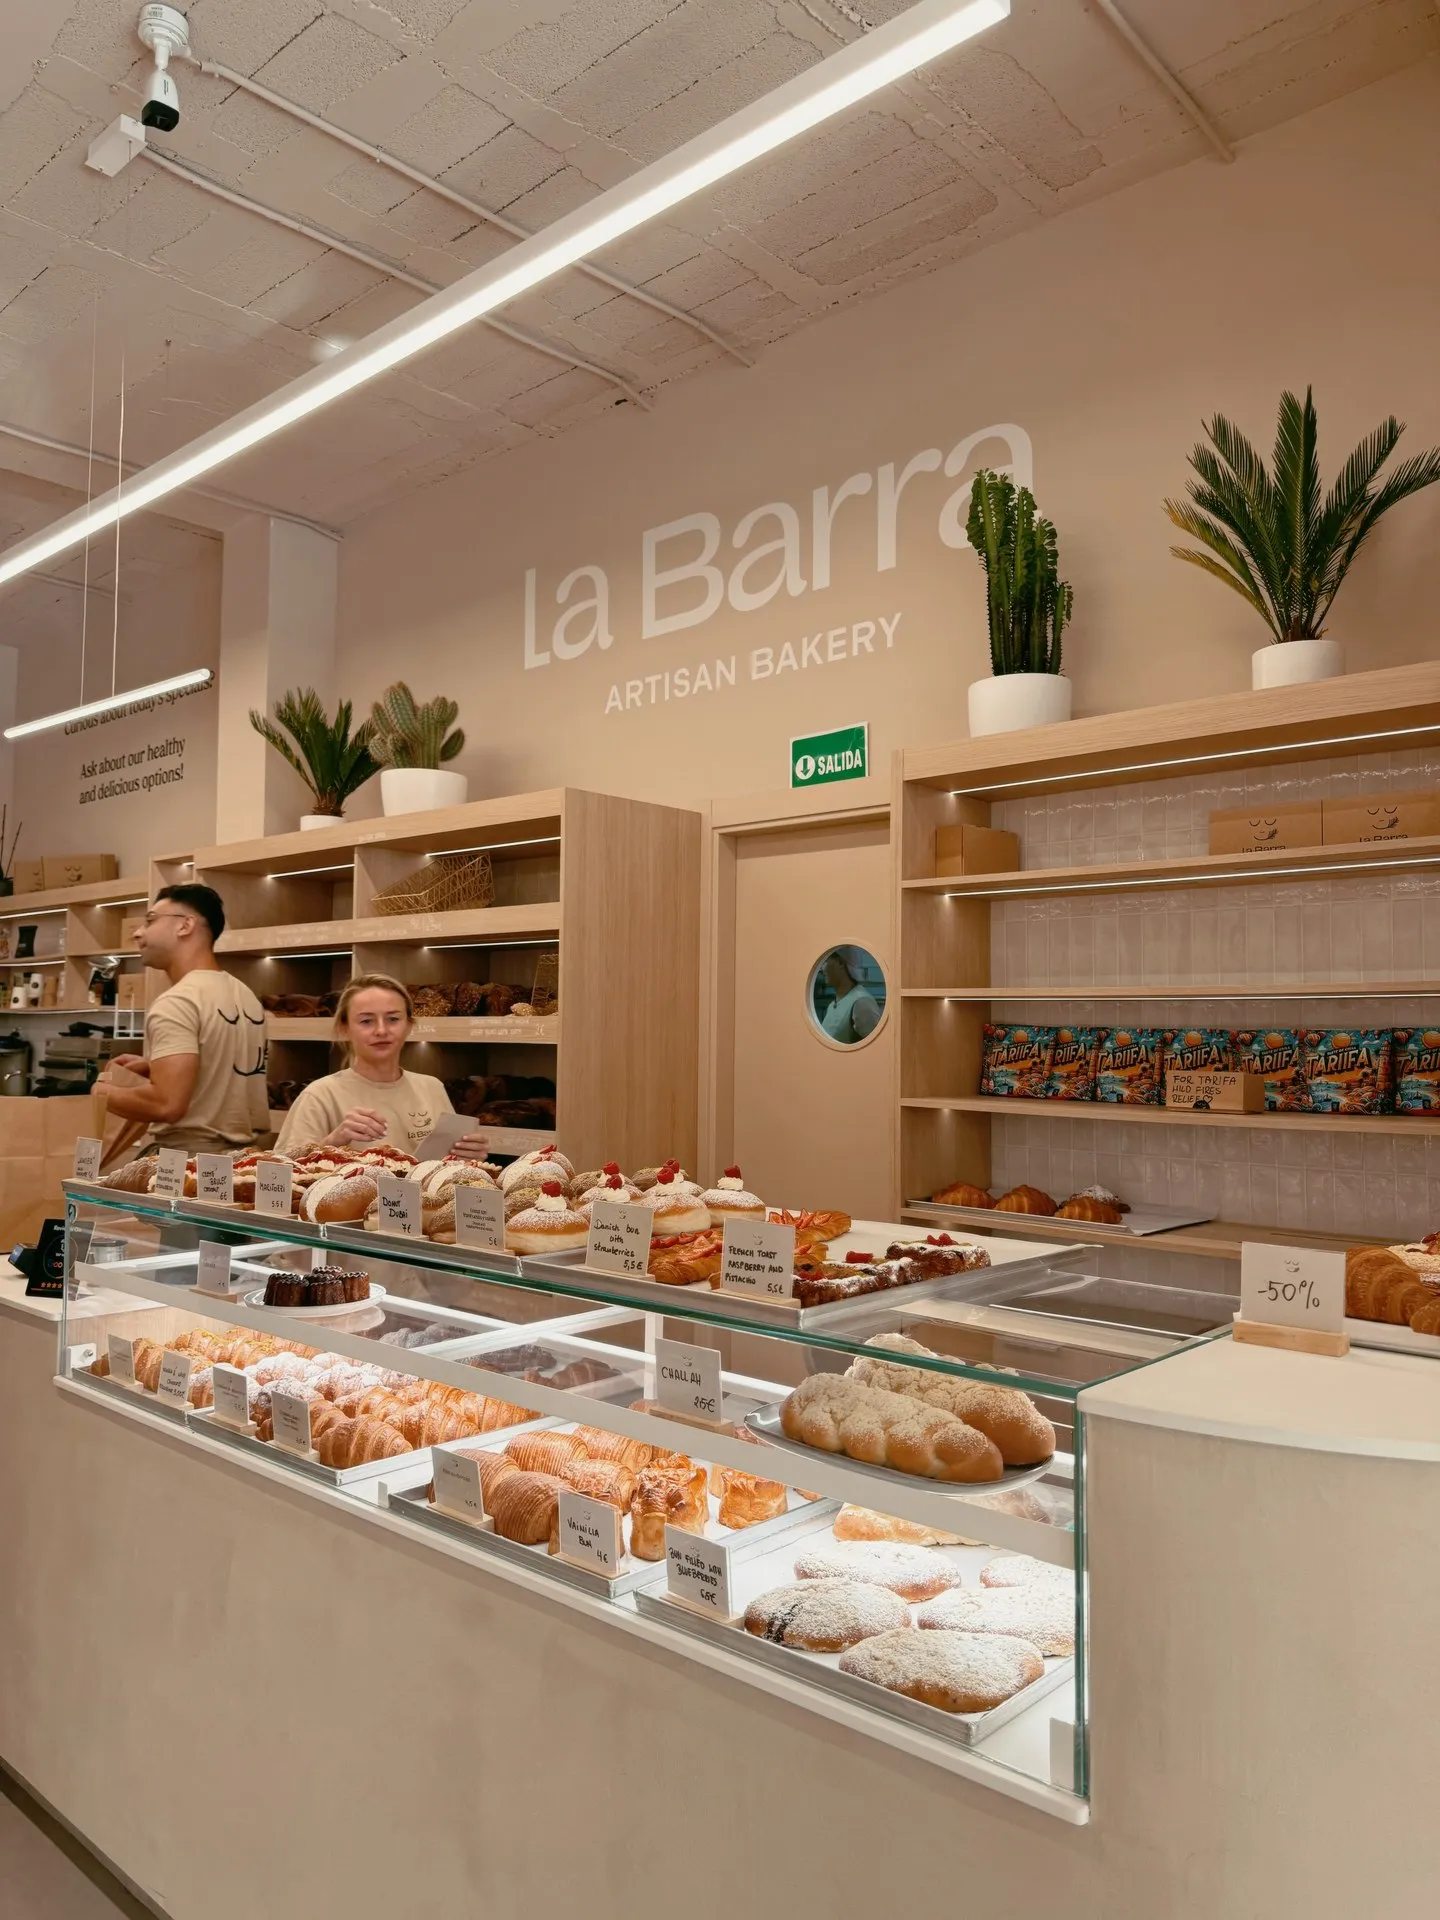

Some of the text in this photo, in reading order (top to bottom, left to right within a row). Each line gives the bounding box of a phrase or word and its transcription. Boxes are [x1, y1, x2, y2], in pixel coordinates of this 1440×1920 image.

[524, 423, 1042, 669] La Barra
[604, 612, 902, 715] ARTISAN BAKERY
[80, 737, 186, 779] Ask about our healthy
[818, 749, 862, 775] SALIDA
[79, 763, 185, 804] and delicious options!
[1173, 1075, 1237, 1086] FOR TARIFA
[1196, 1086, 1222, 1095] FIRES
[402, 1223, 411, 1233] 7€
[594, 1218, 620, 1232] Danish
[728, 1245, 778, 1260] FRENCH TOAST
[728, 1260, 784, 1273] RASPBERRY AND
[1257, 1279, 1320, 1310] -50%
[661, 1366, 701, 1387] CHALLAH
[596, 1549, 609, 1564] 4€
[685, 1554, 705, 1570] FILLED
[676, 1563, 718, 1587] BLUEBERRIES
